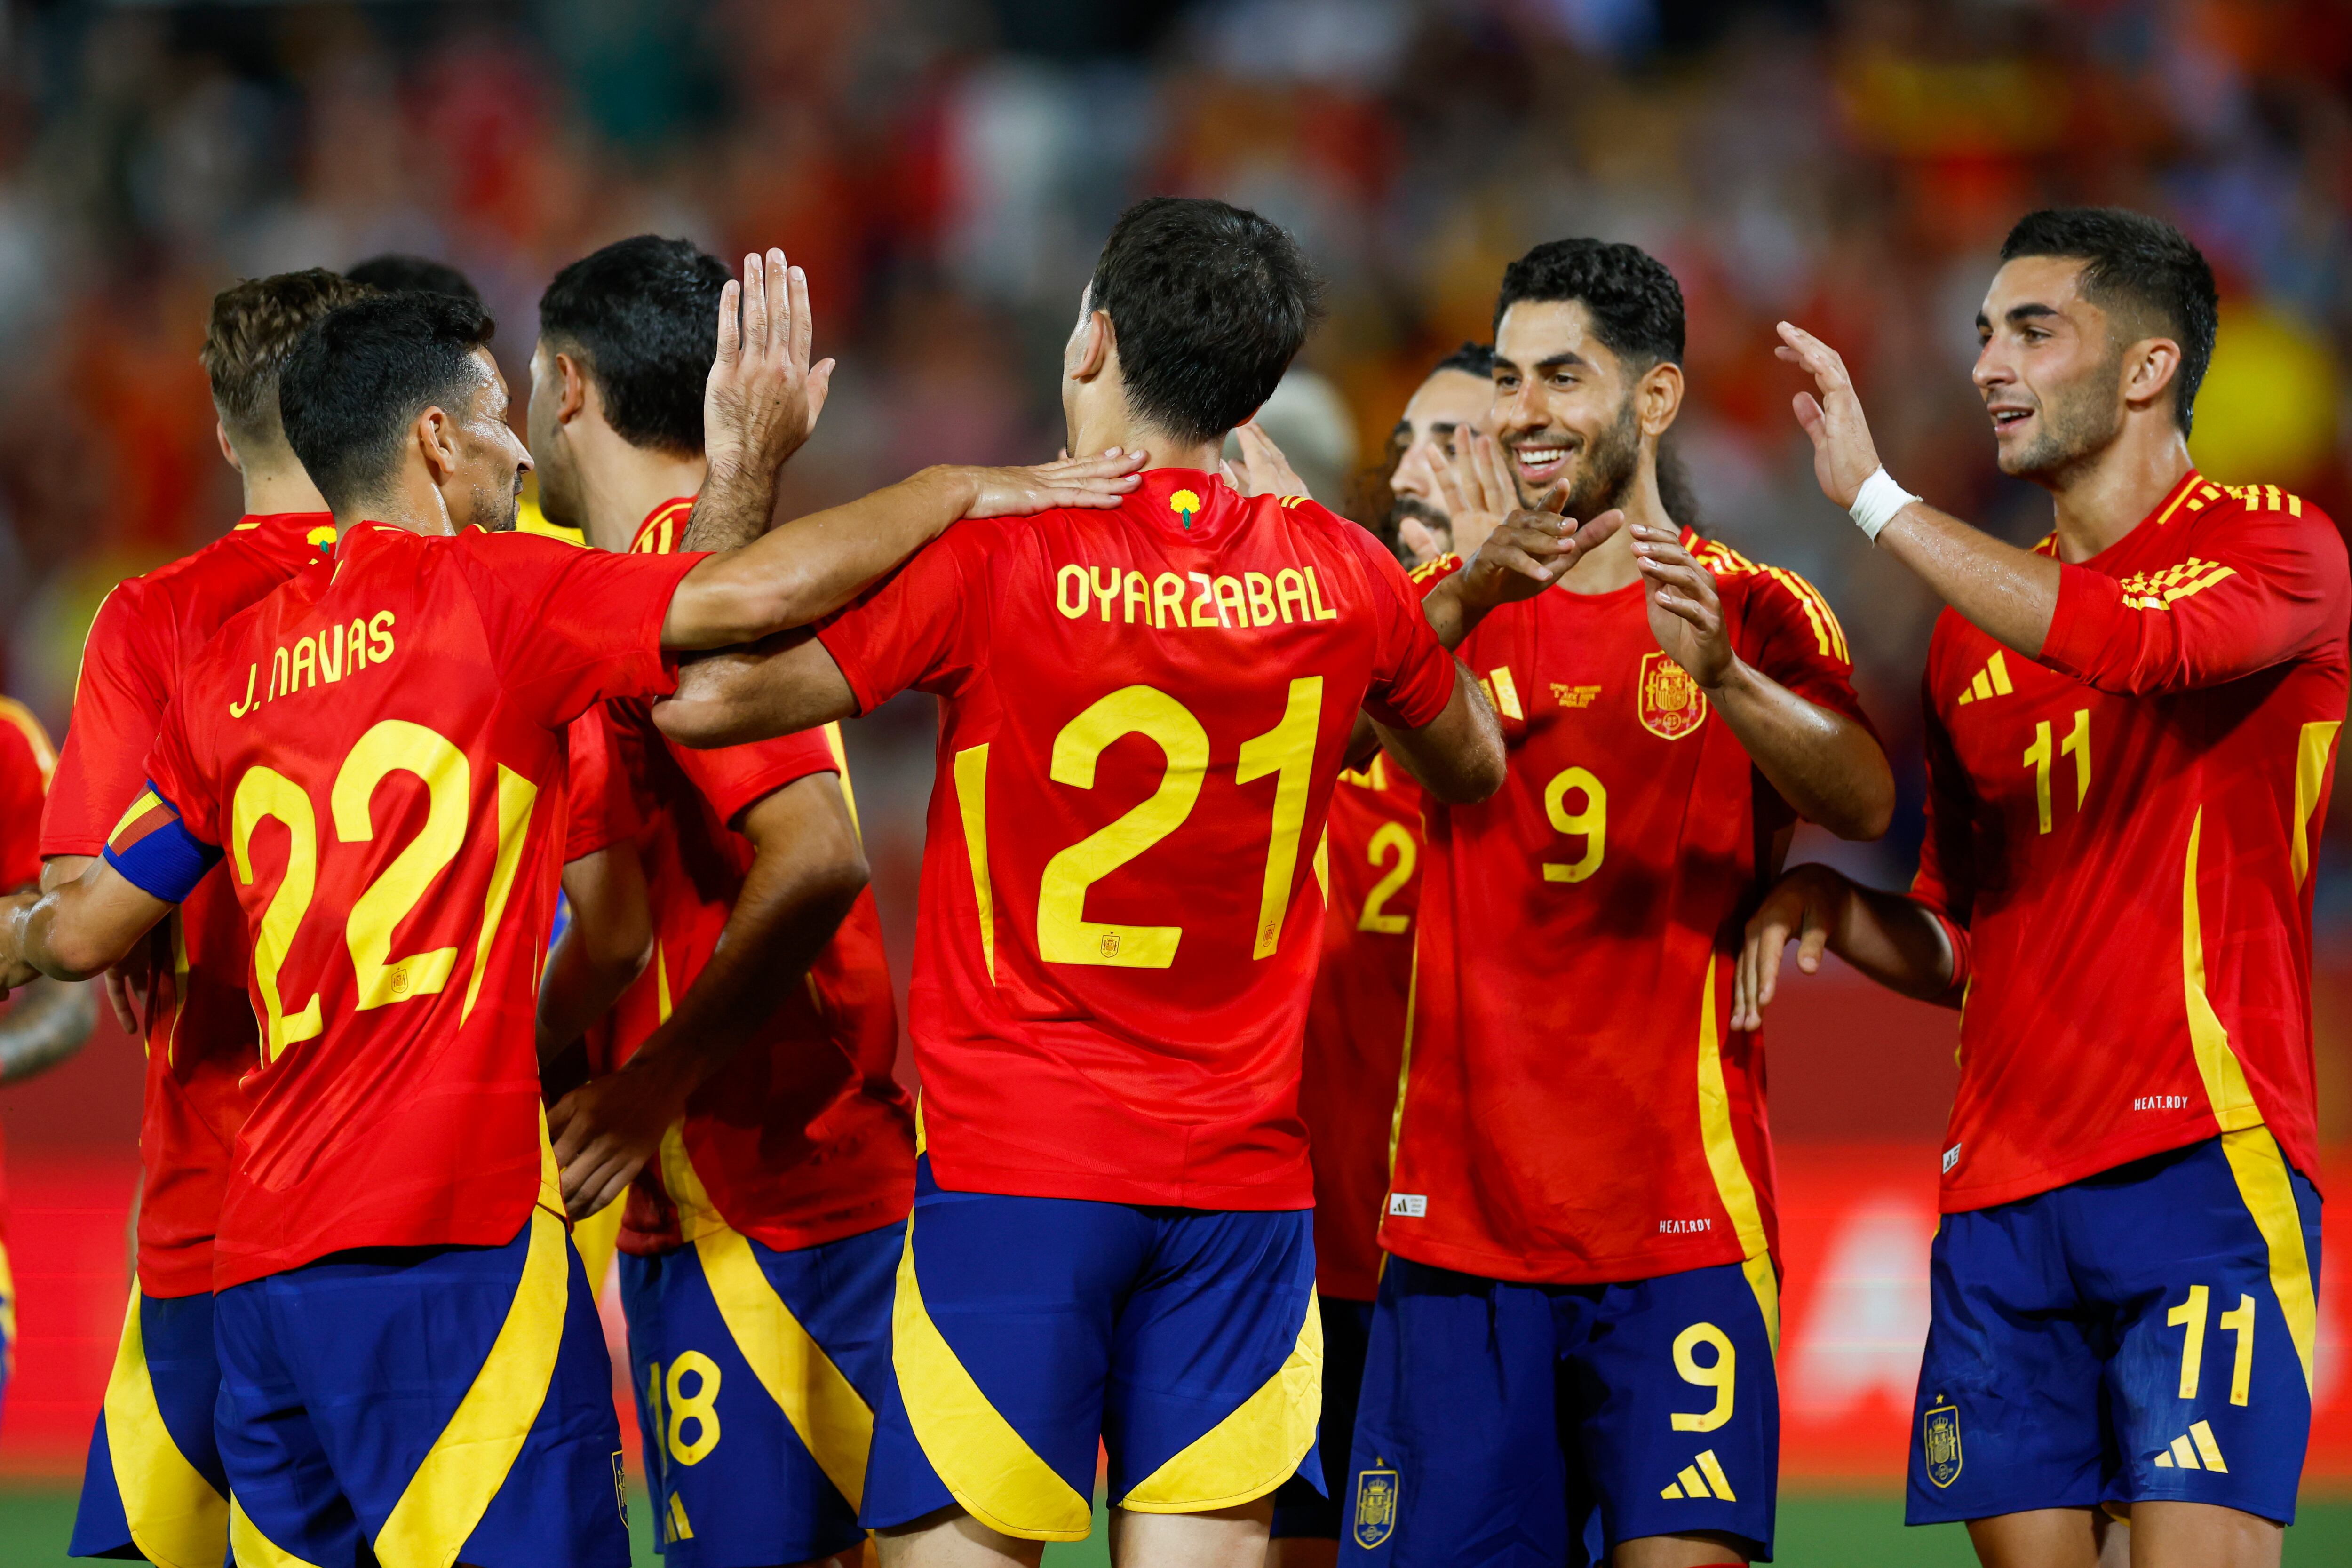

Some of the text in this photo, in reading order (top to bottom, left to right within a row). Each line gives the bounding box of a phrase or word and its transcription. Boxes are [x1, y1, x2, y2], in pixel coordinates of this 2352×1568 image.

[1057, 564, 1337, 629] OYARZABAL
[229, 610, 396, 718] J. NAVAS
[1037, 676, 1323, 968] 21
[1542, 766, 1607, 883] 9
[2023, 709, 2091, 835] 11
[232, 720, 470, 1063] 22
[2134, 1095, 2188, 1111] HEAT.RDY
[1659, 1218, 1711, 1233] HEAT.RDY
[1670, 1322, 1736, 1433] 9
[2167, 1284, 2256, 1407] 11
[648, 1350, 722, 1476] 18
